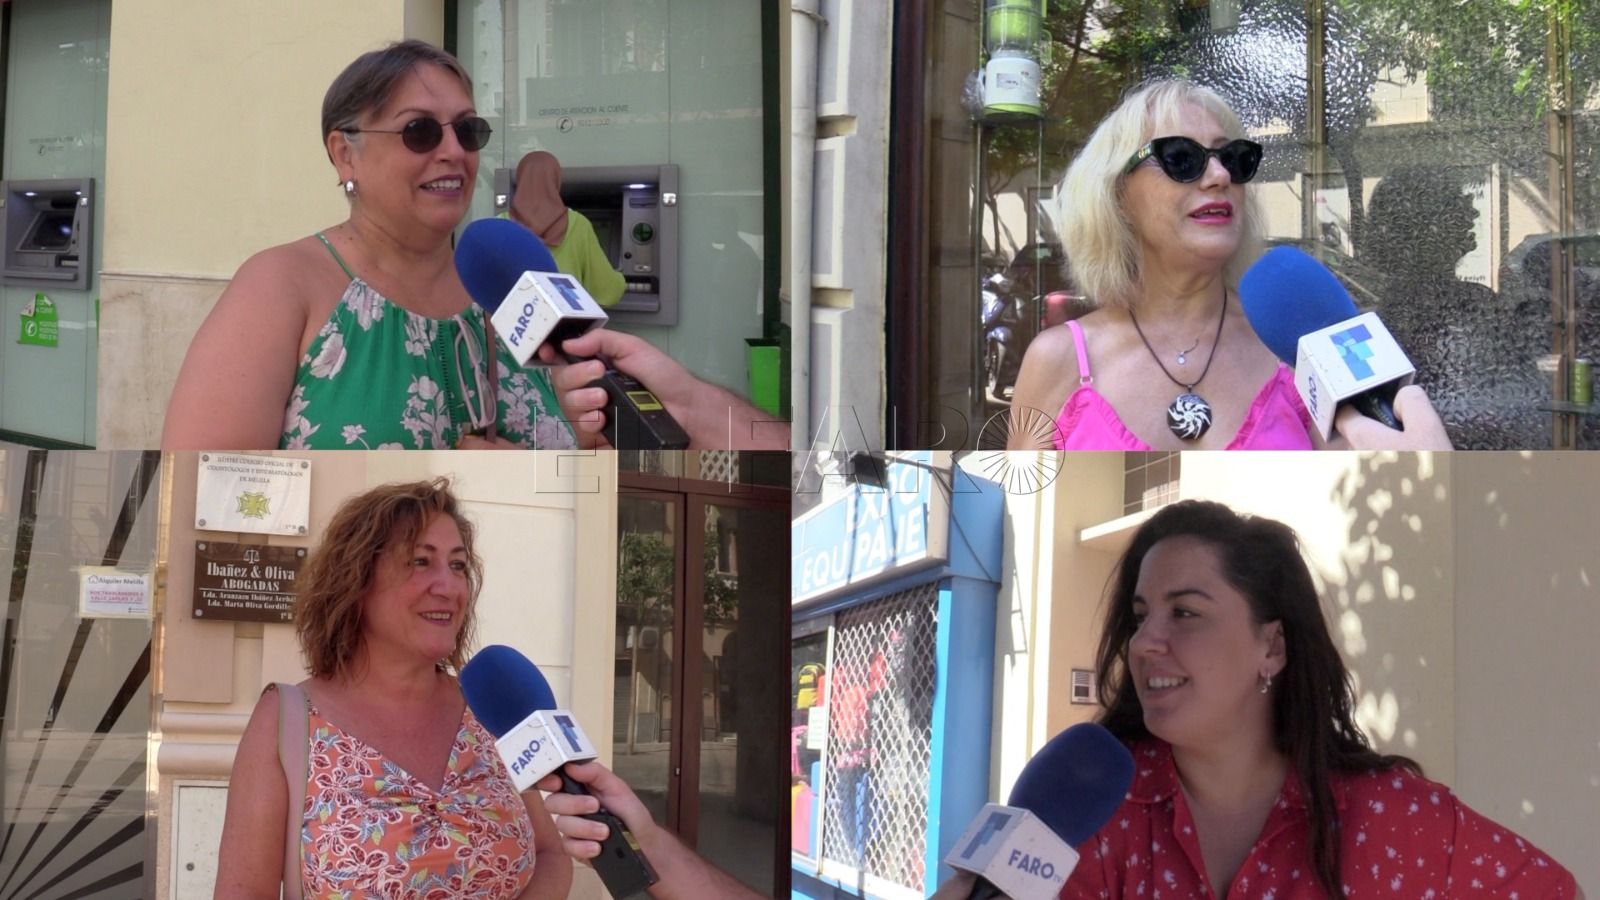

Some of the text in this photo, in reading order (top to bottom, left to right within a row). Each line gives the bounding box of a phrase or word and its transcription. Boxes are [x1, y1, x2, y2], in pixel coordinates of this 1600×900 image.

[509, 303, 535, 347] FARO
[207, 562, 296, 580] Ibañez & Oliva
[221, 578, 280, 592] ABOGADAS
[245, 601, 262, 609] Oliva
[511, 739, 541, 775] FARO
[1008, 849, 1054, 879] FARO
